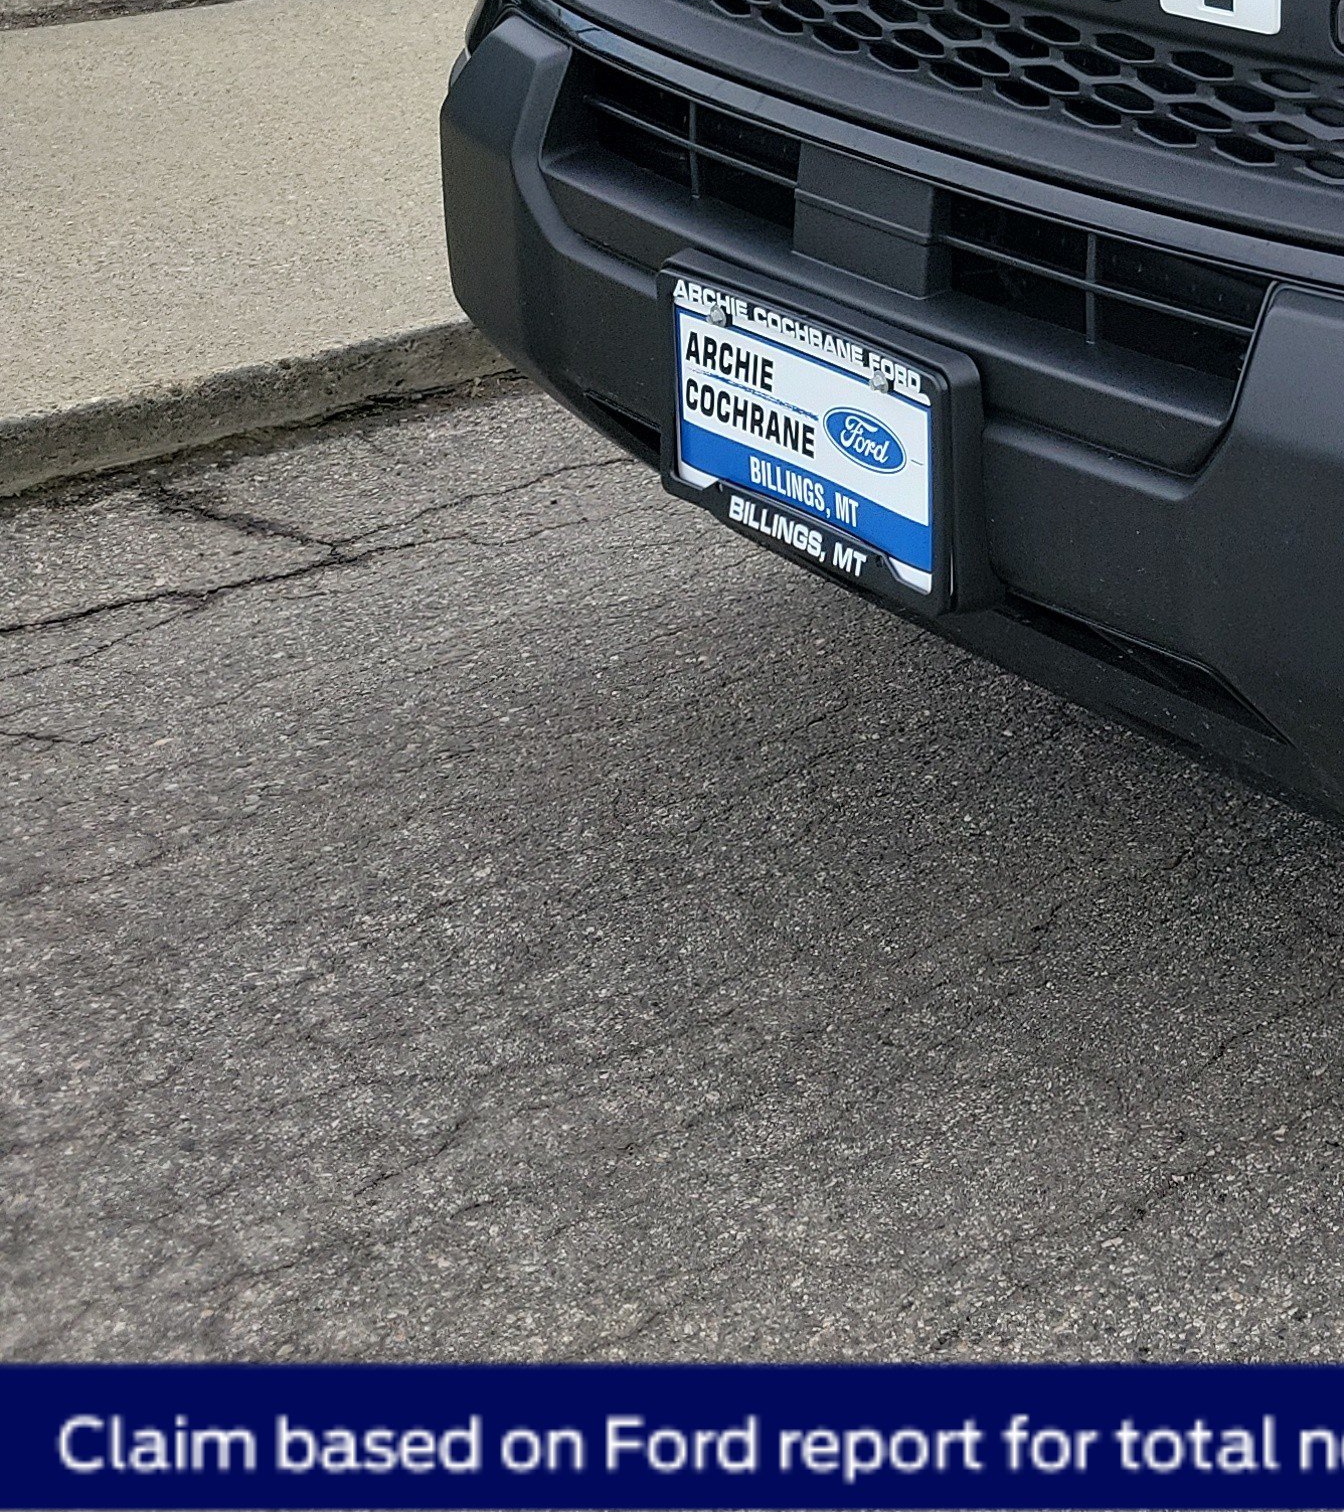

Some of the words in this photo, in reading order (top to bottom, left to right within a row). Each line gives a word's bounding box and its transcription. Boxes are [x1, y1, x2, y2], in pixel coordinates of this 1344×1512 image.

[673, 279, 748, 321] ARCHIE
[754, 307, 864, 366] COCHRANE
[869, 353, 921, 393] FORD
[686, 331, 775, 393] ARCHIE
[686, 379, 816, 459] COCHRANE
[840, 416, 889, 465] Ford
[749, 456, 831, 519] BILLINGS,
[835, 497, 859, 528] MT
[729, 495, 825, 562] BILLINGS,
[833, 542, 867, 576] MT
